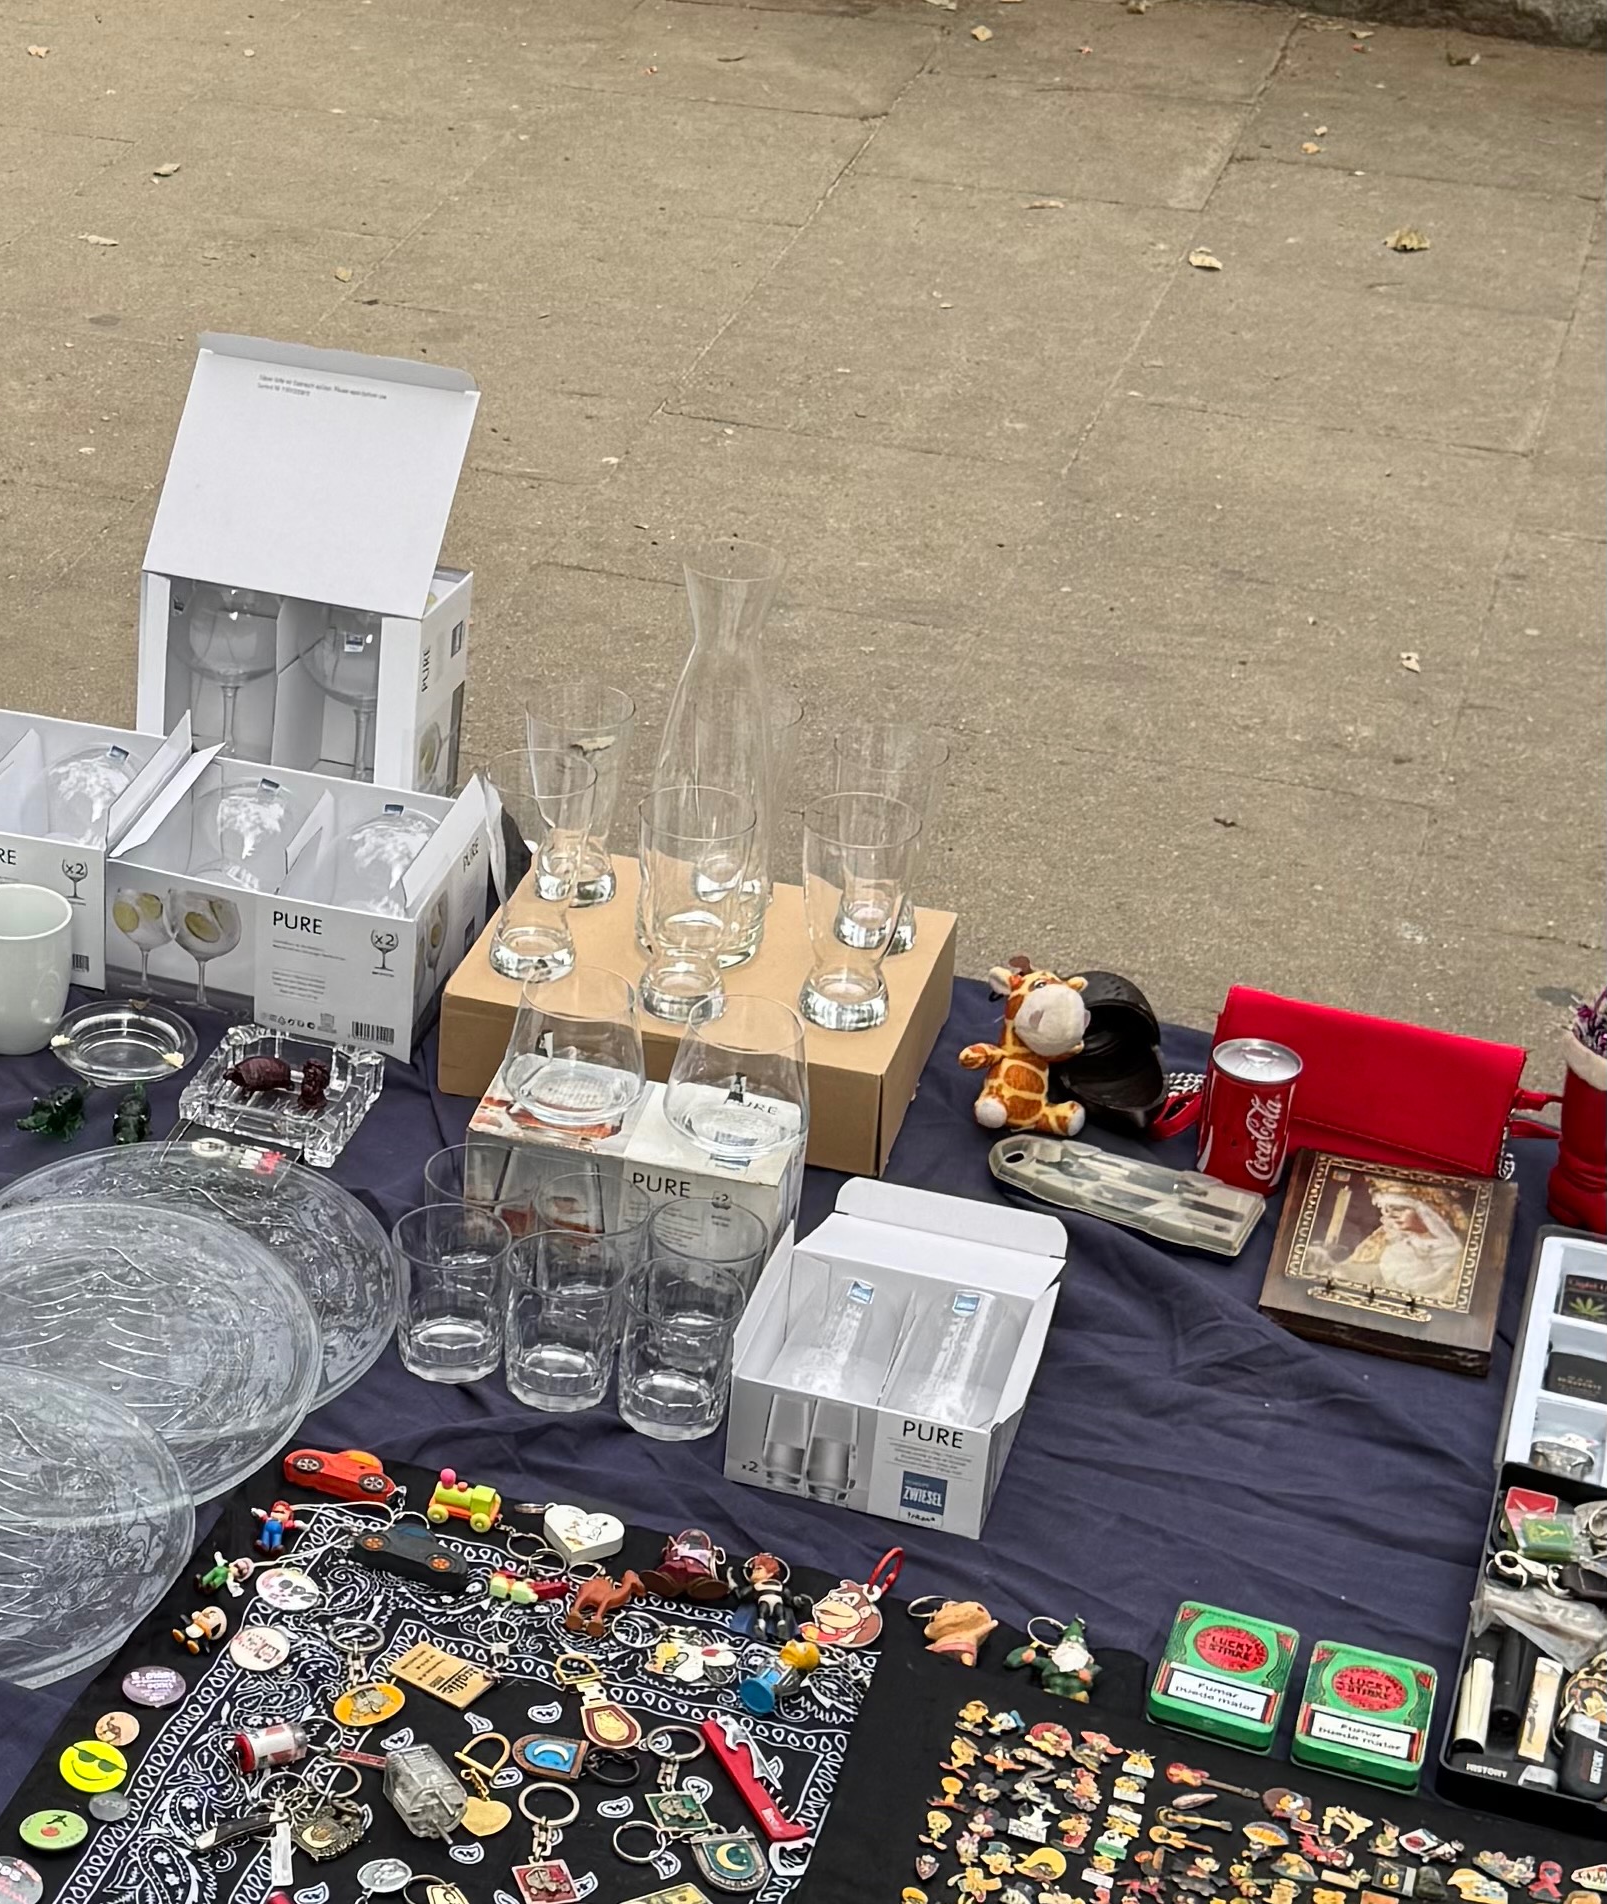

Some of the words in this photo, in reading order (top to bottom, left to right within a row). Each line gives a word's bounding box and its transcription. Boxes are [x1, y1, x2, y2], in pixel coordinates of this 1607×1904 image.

[65, 863, 87, 876] x2
[273, 910, 323, 935] PURE
[374, 933, 395, 947] x2
[728, 1099, 779, 1116] URE
[633, 1172, 691, 1197] PURE
[902, 1420, 964, 1449] PURE
[741, 1461, 759, 1473] x2
[1210, 1635, 1252, 1653] LUCKY
[1197, 1682, 1238, 1699] Fumar
[1347, 1675, 1392, 1692] LUCKY
